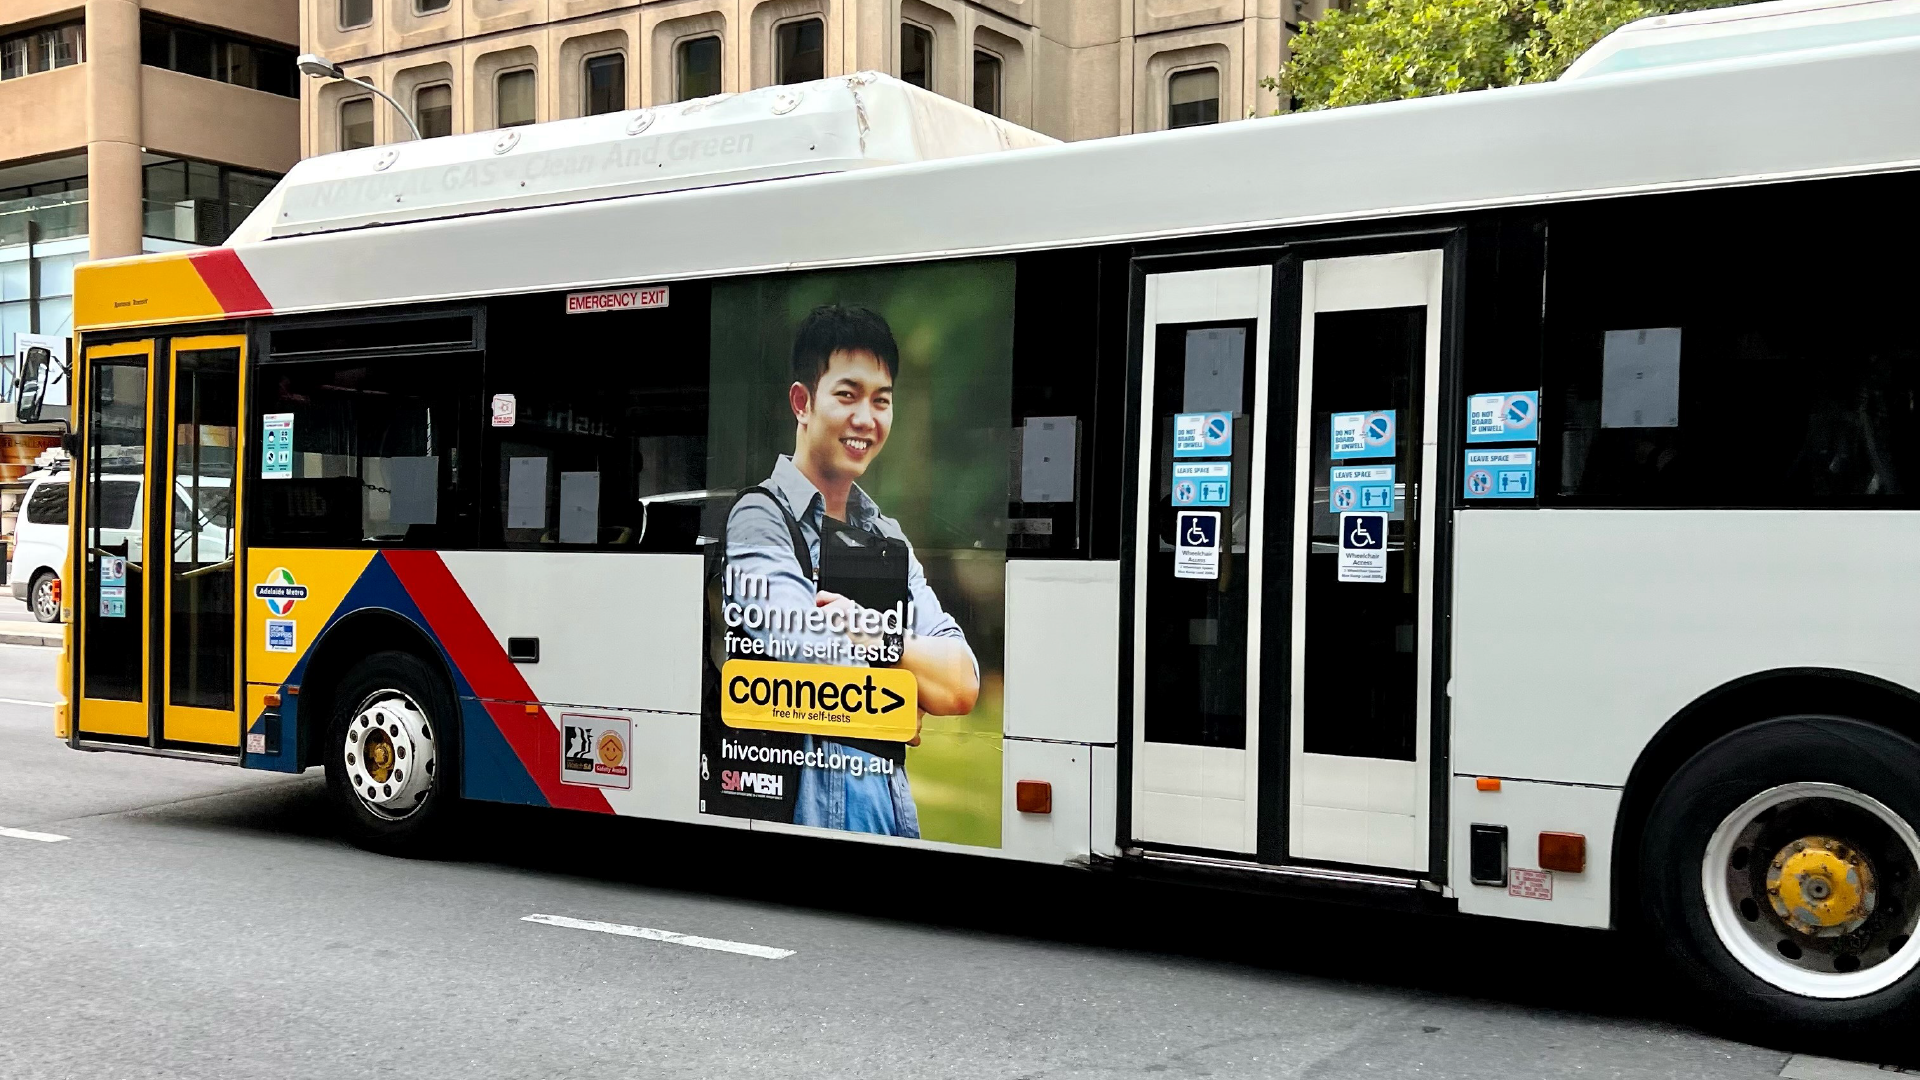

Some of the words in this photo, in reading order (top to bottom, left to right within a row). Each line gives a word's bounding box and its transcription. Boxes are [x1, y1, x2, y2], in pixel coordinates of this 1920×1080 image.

[442, 161, 499, 192] GAS
[525, 153, 596, 180] Clean
[602, 136, 662, 170] And
[666, 132, 755, 163] Green
[569, 292, 638, 310] EMERGENCY
[641, 290, 666, 305] EXIT
[259, 588, 284, 596] Adelaide
[286, 588, 304, 596] Metro
[725, 564, 769, 597] I'm
[724, 601, 915, 635] connected!
[724, 632, 765, 655] free
[769, 634, 797, 656] hiv
[802, 638, 900, 663] self-tests
[772, 708, 790, 719] free
[793, 709, 806, 720] hiv
[807, 711, 851, 724] self-tests
[596, 765, 611, 774] Safety
[721, 738, 894, 777] hivconnect.org.au
[721, 770, 783, 796] SAMESH
